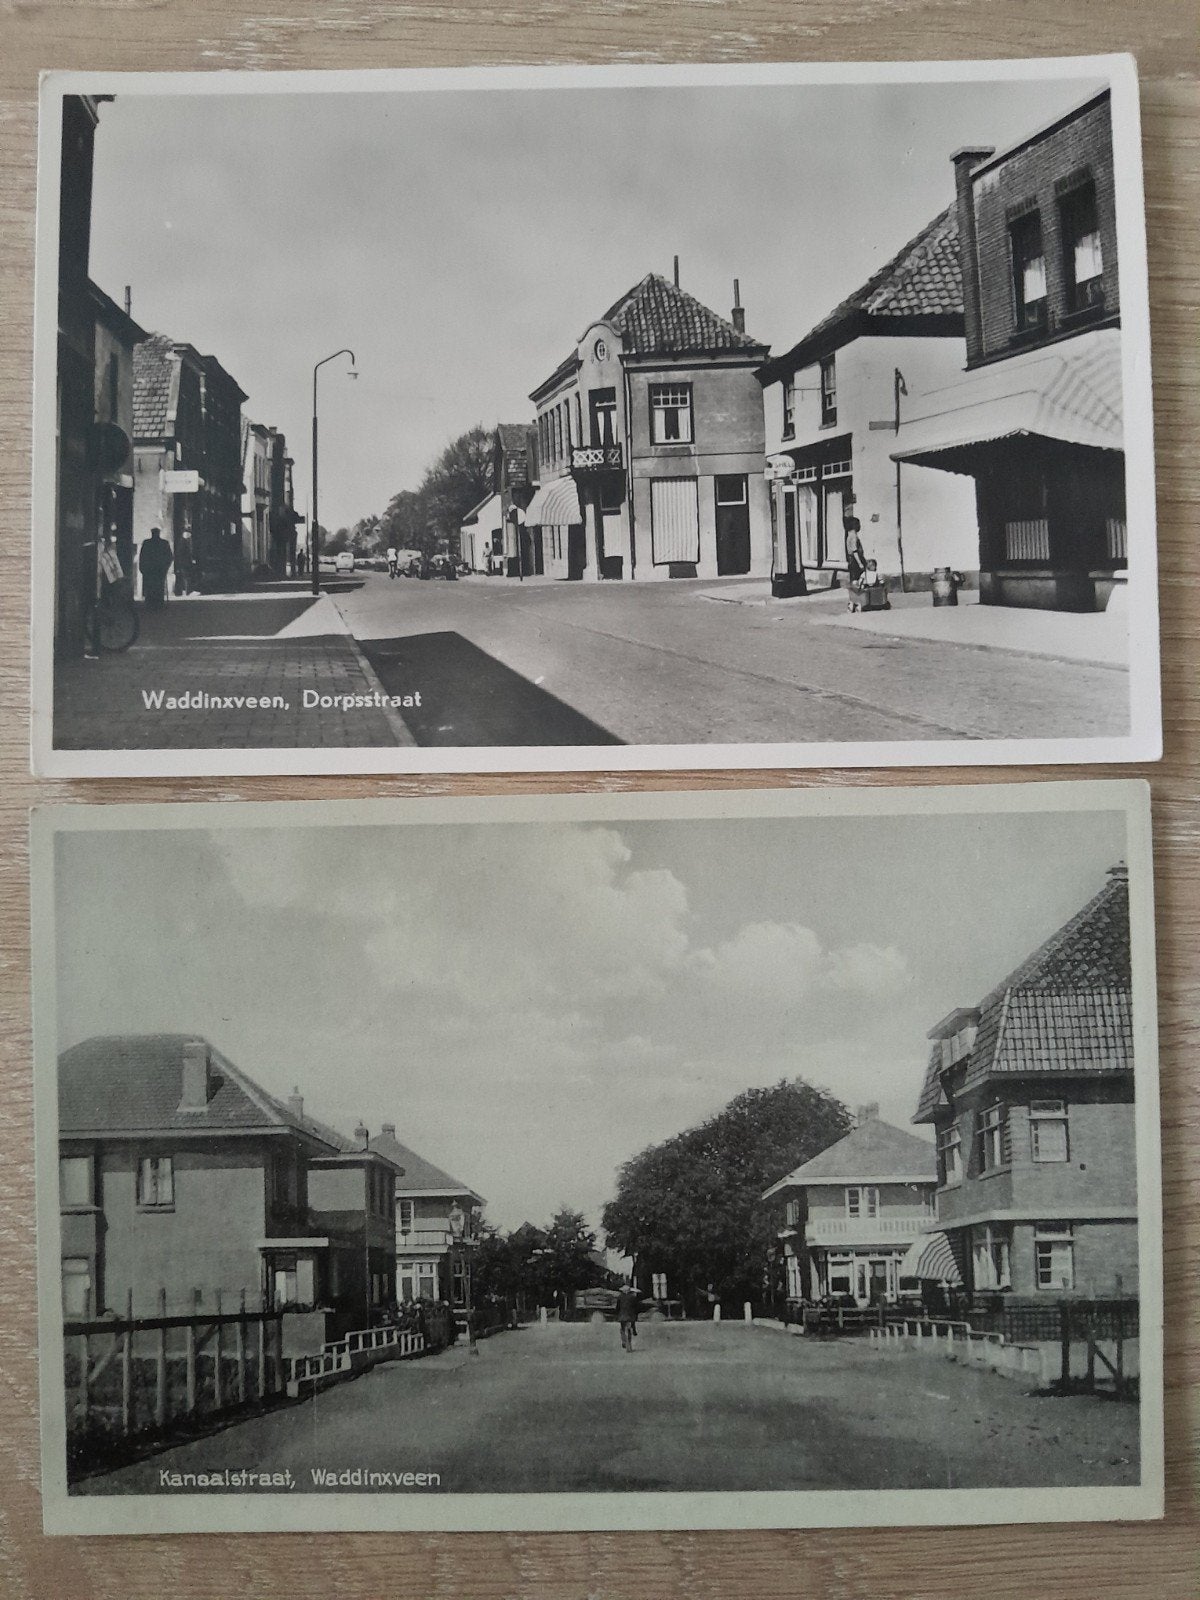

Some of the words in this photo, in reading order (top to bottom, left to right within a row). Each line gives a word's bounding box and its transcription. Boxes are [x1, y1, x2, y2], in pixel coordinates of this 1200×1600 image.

[141, 690, 290, 711] Waddinxveen,
[302, 689, 422, 711] Dorpsstraat
[159, 1469, 296, 1489] Kanaalstraat,
[311, 1468, 441, 1486] Waddinxveen
